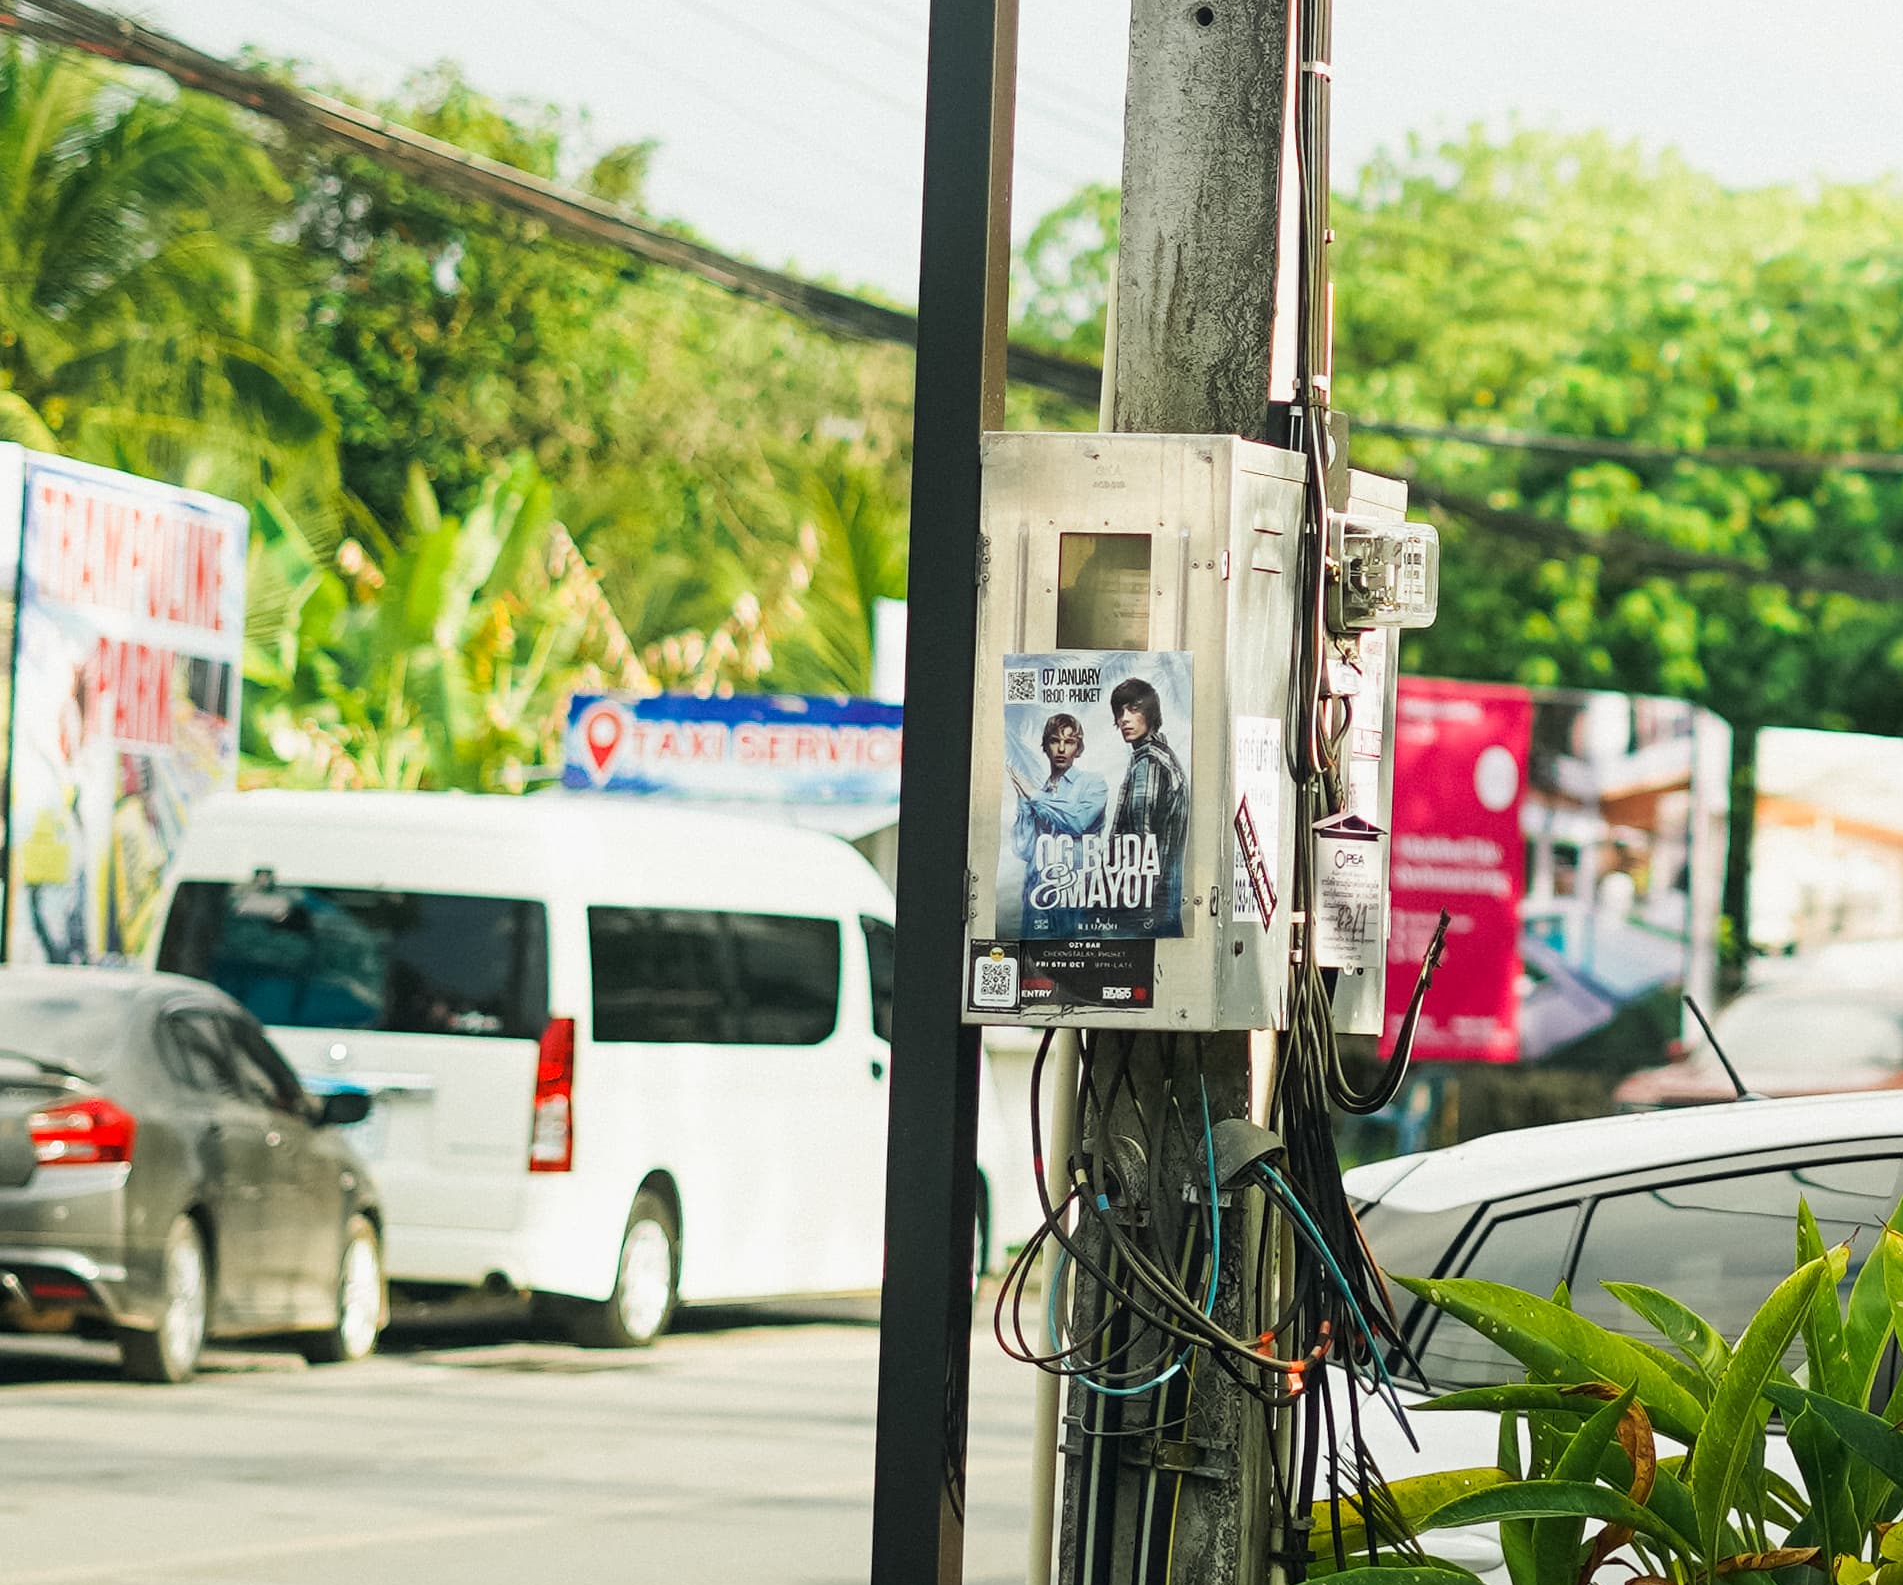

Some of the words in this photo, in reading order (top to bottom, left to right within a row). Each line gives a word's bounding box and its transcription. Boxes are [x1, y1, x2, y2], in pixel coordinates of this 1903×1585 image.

[1042, 668, 1055, 686] 07
[1056, 668, 1101, 686] JANUARY
[1068, 688, 1102, 703] PHUKET
[633, 730, 725, 762] TAXI
[740, 730, 901, 763] SERVIC
[1035, 833, 1074, 871] OG
[1081, 833, 1161, 876] BUDA
[1059, 869, 1159, 909] MAYOT
[1020, 989, 1053, 998] ENTRY
